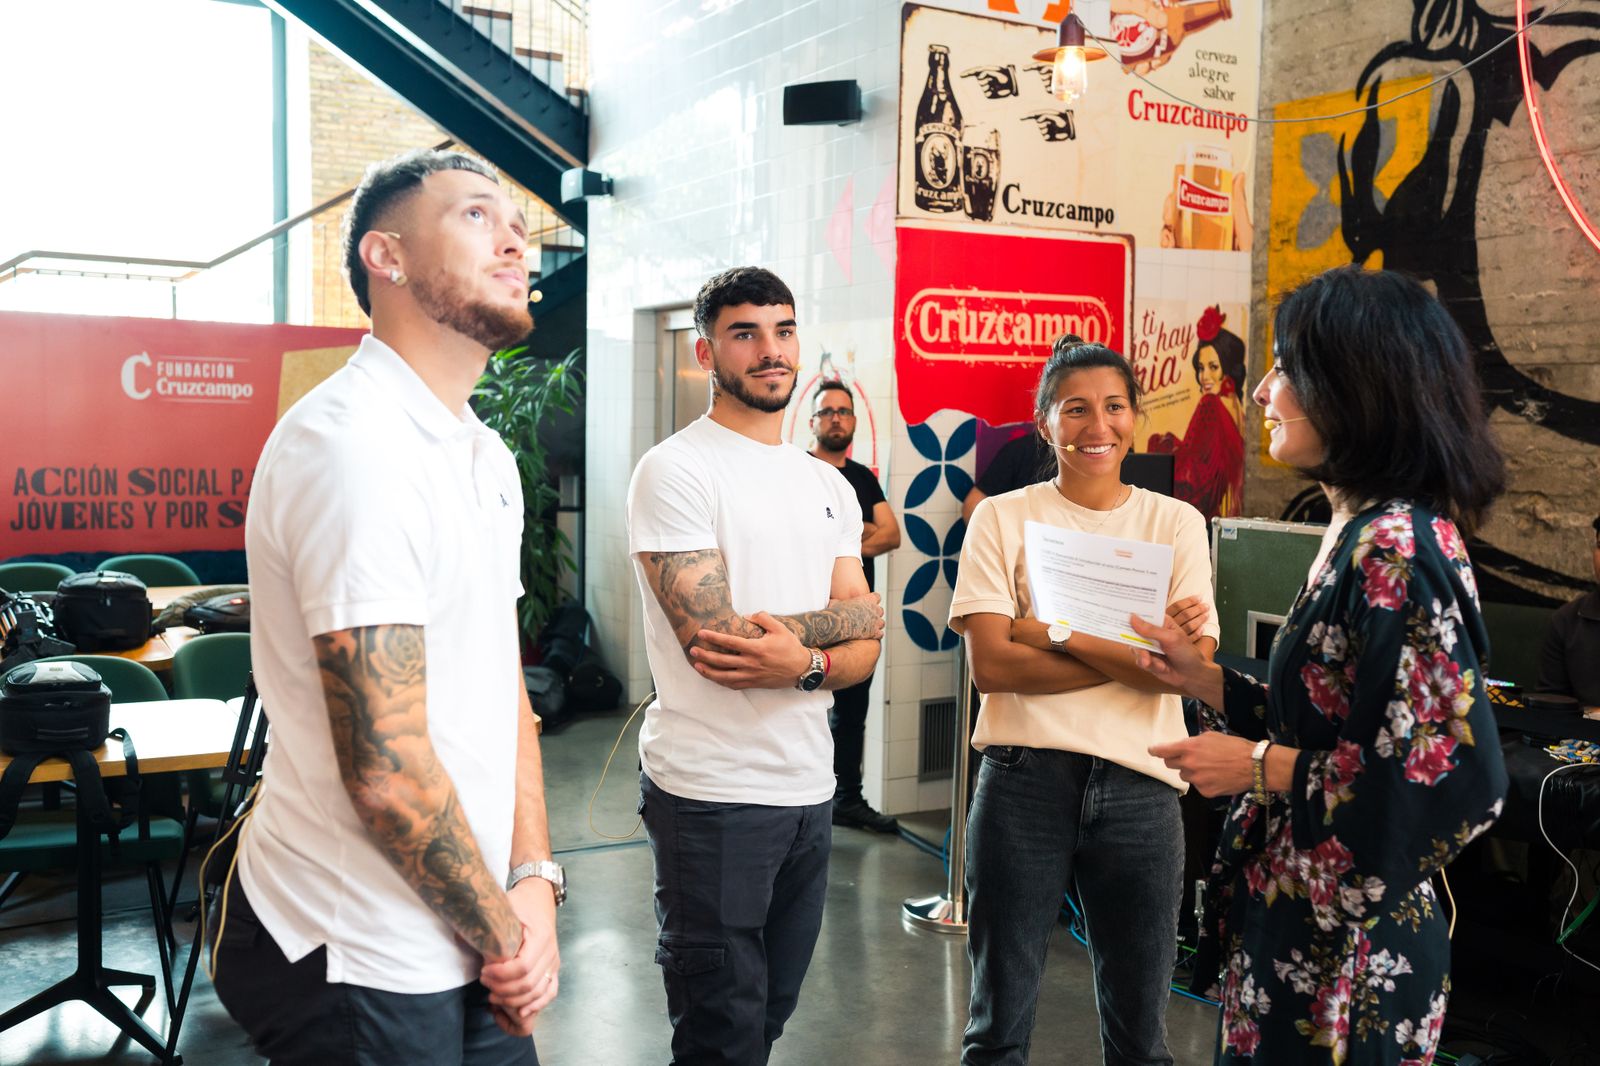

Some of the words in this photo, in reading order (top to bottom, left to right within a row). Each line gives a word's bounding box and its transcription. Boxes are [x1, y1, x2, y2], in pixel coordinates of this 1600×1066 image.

[1195, 49, 1238, 65] cerveza
[1188, 62, 1230, 83] alegre
[1203, 85, 1236, 102] sabor
[1127, 88, 1249, 139] Cruzcampo
[1002, 182, 1115, 229] Cruzcampo
[1181, 184, 1229, 212] Cruzcampo
[1142, 309, 1157, 337] ti
[1156, 321, 1195, 360] hay
[157, 360, 235, 379] FUNDACIÓN
[156, 376, 254, 400] Cruzcampo
[13, 464, 118, 497] ACCIÓN
[127, 467, 223, 496] SOCIAL
[10, 497, 134, 531] JÓVENES
[142, 501, 157, 529] Y
[166, 501, 209, 529] POR
